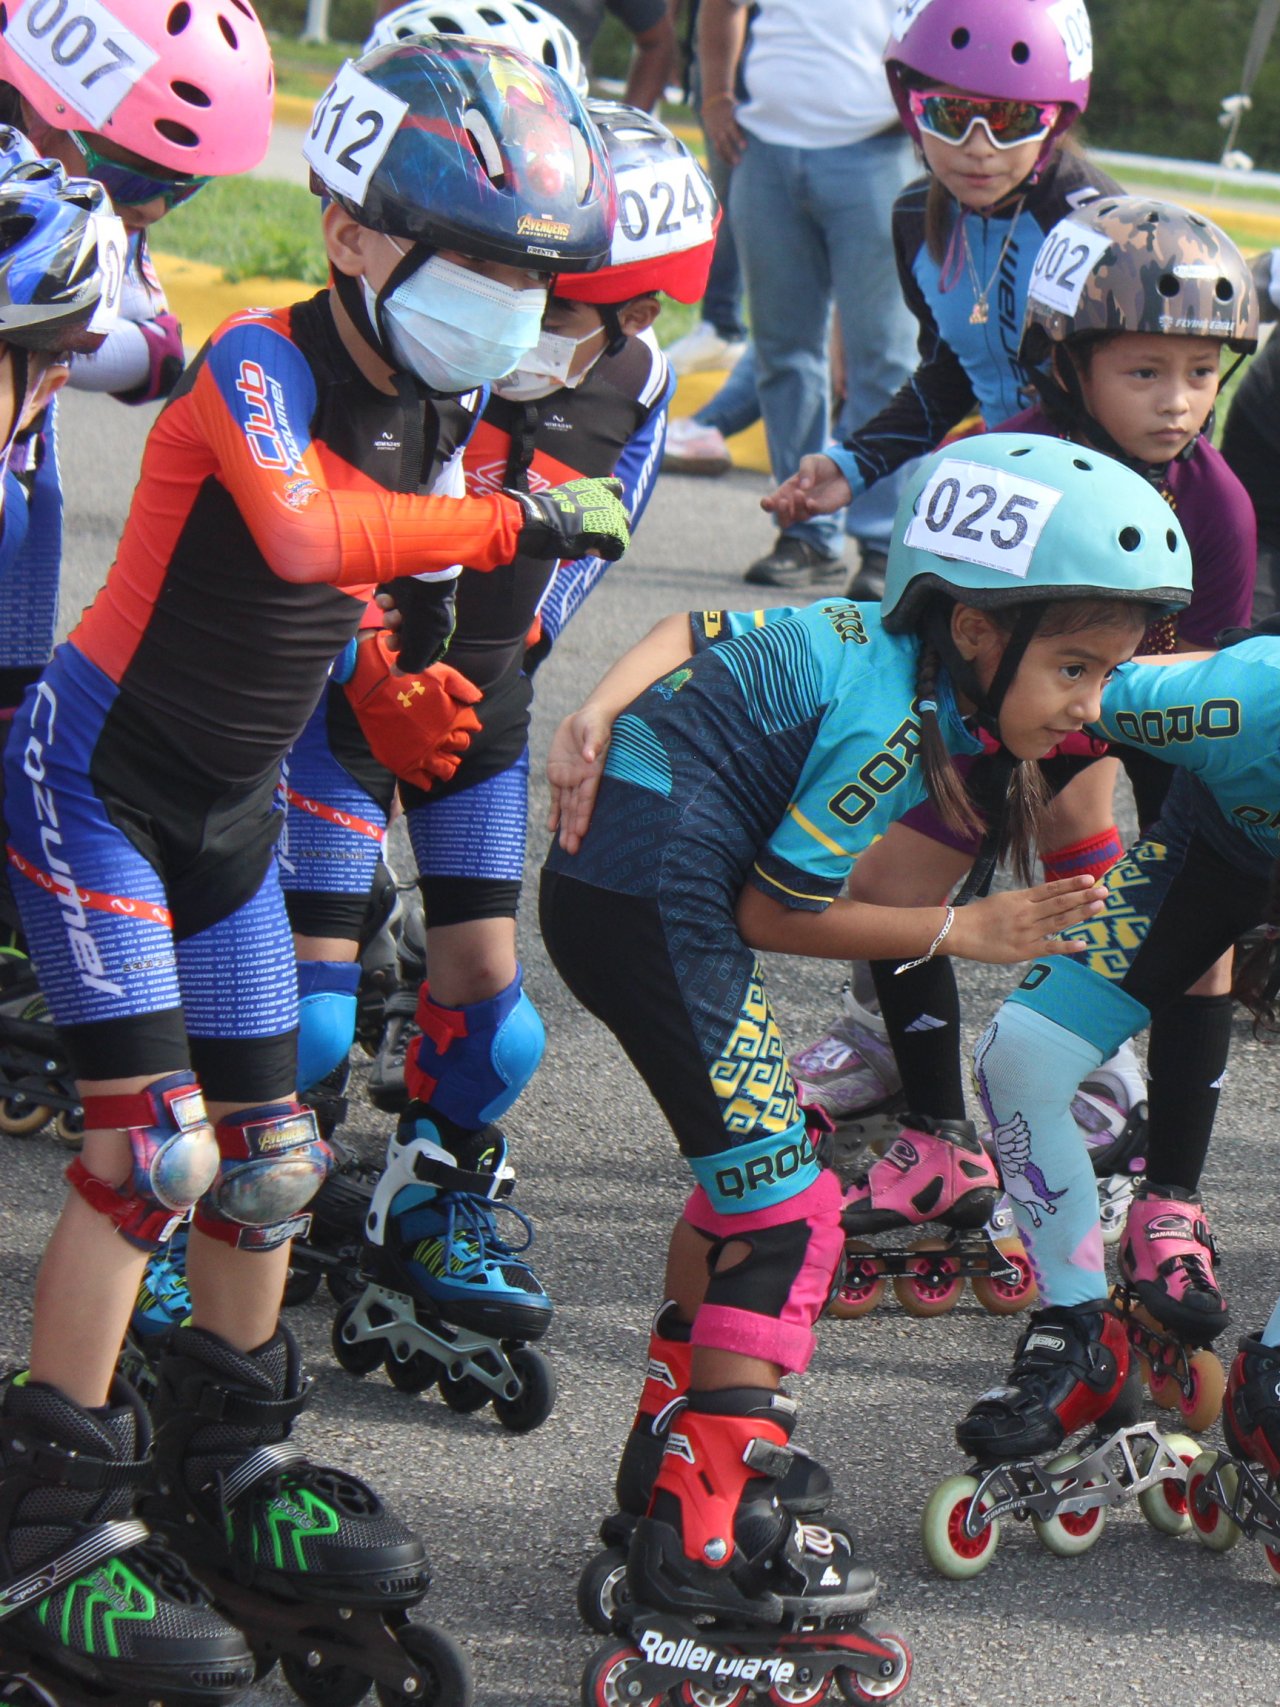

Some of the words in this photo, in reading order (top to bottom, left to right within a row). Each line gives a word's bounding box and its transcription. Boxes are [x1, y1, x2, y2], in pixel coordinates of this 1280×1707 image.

[27, 0, 135, 90] 007
[311, 82, 384, 177] 012
[619, 173, 704, 242] 024
[1034, 232, 1091, 293] 002
[236, 359, 291, 471] Club
[925, 477, 1040, 550] 025
[1114, 698, 1241, 748] QROO
[24, 680, 123, 996] Cozumel
